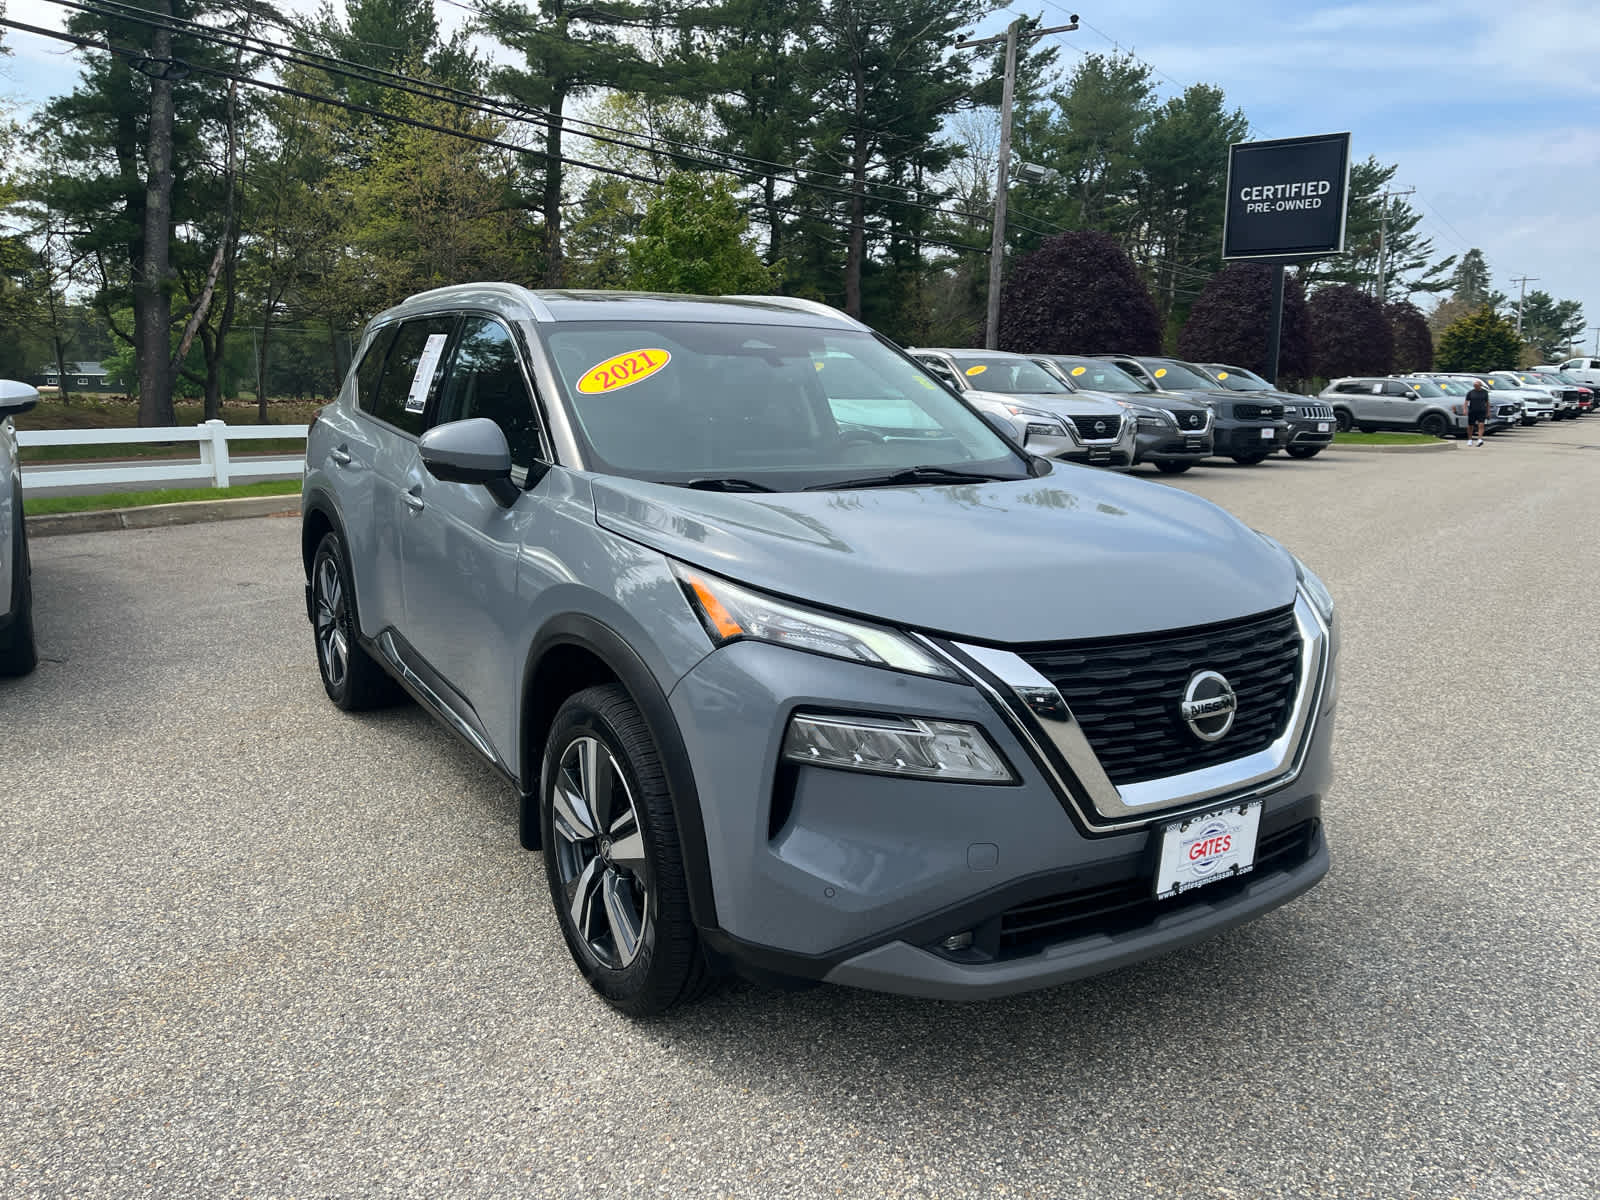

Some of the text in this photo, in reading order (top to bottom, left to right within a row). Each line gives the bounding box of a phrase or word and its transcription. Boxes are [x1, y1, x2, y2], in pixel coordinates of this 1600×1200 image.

[1240, 180, 1331, 201] CERTIFIED
[1246, 198, 1322, 214] PRE-OWNED
[594, 351, 658, 389] 2021
[1191, 698, 1232, 714] NISSAN
[1188, 834, 1232, 861] GATES
